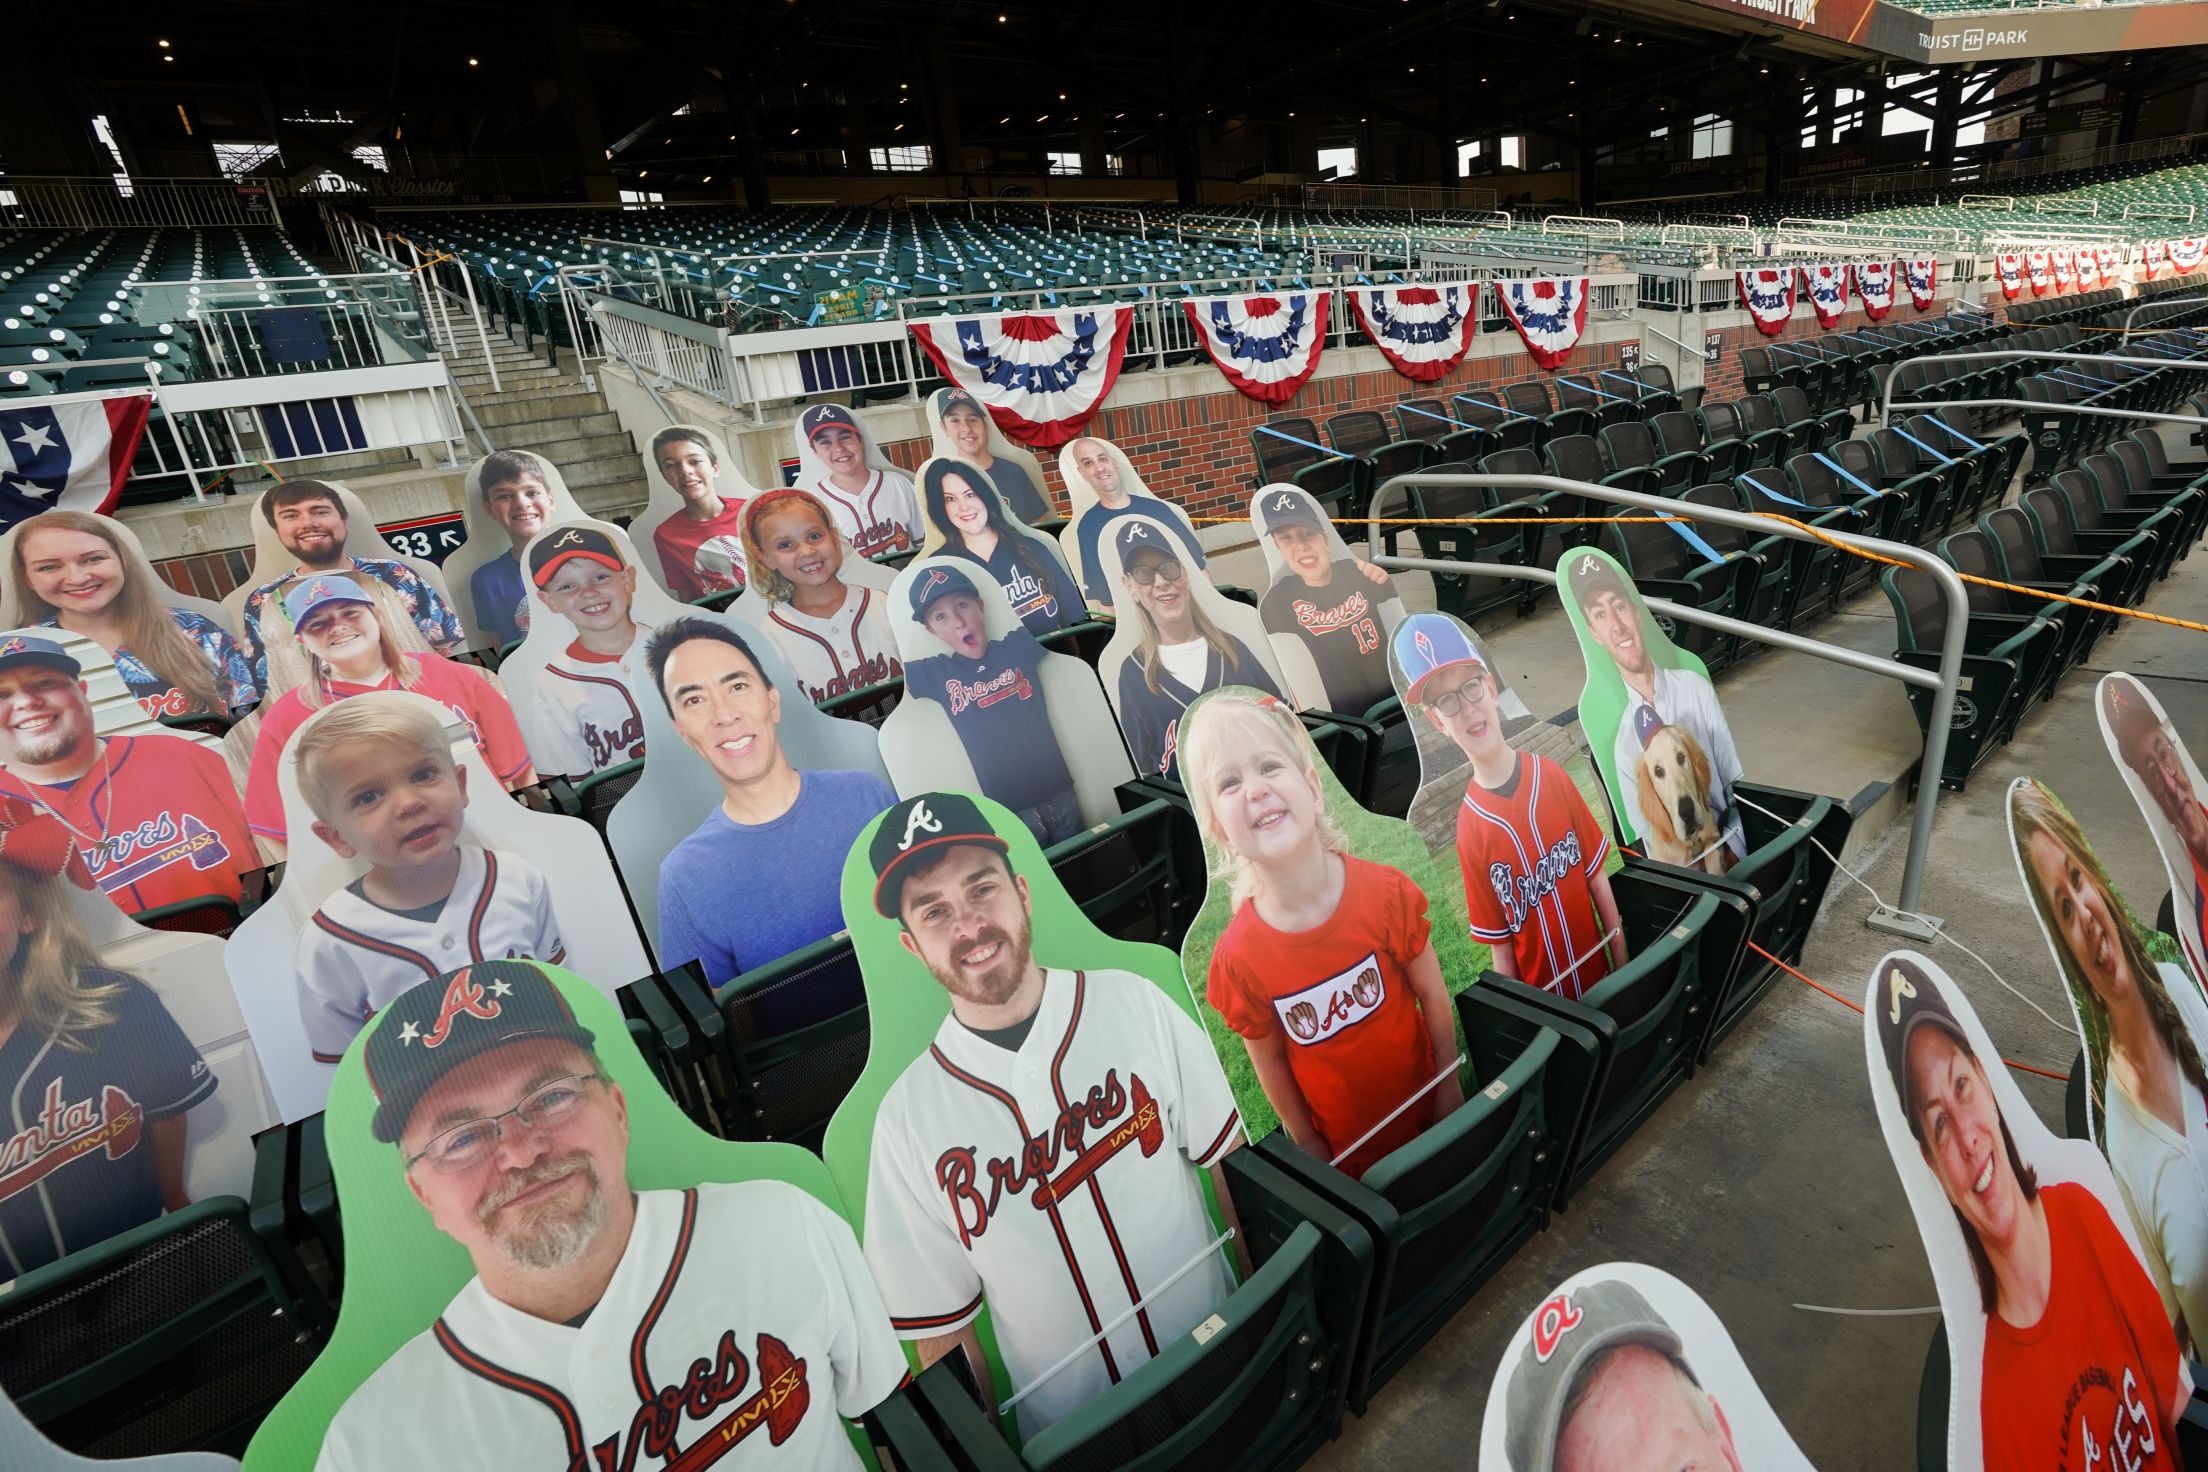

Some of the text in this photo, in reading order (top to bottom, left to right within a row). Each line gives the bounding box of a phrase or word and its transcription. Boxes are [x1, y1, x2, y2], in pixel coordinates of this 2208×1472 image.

[1918, 29, 2029, 49] TRUIST PARK
[1842, 158, 1867, 169] STORE
[389, 176, 457, 194] Classics
[1711, 334, 1721, 345] 137
[1622, 346, 1634, 358] 135
[816, 406, 835, 422] A
[1273, 493, 1295, 511] A
[554, 530, 584, 548] A
[1126, 522, 1148, 543] A
[1578, 555, 1600, 576] A
[304, 581, 335, 605] A
[1292, 591, 1369, 626] Braves
[1352, 618, 1380, 654] 13
[946, 668, 1016, 716] Braves
[1642, 709, 1653, 727] A
[897, 799, 943, 851] A
[422, 967, 502, 1049] A
[1321, 990, 1349, 1032] A
[935, 1068, 1127, 1252] Braves
[1205, 1323, 1214, 1335] 5
